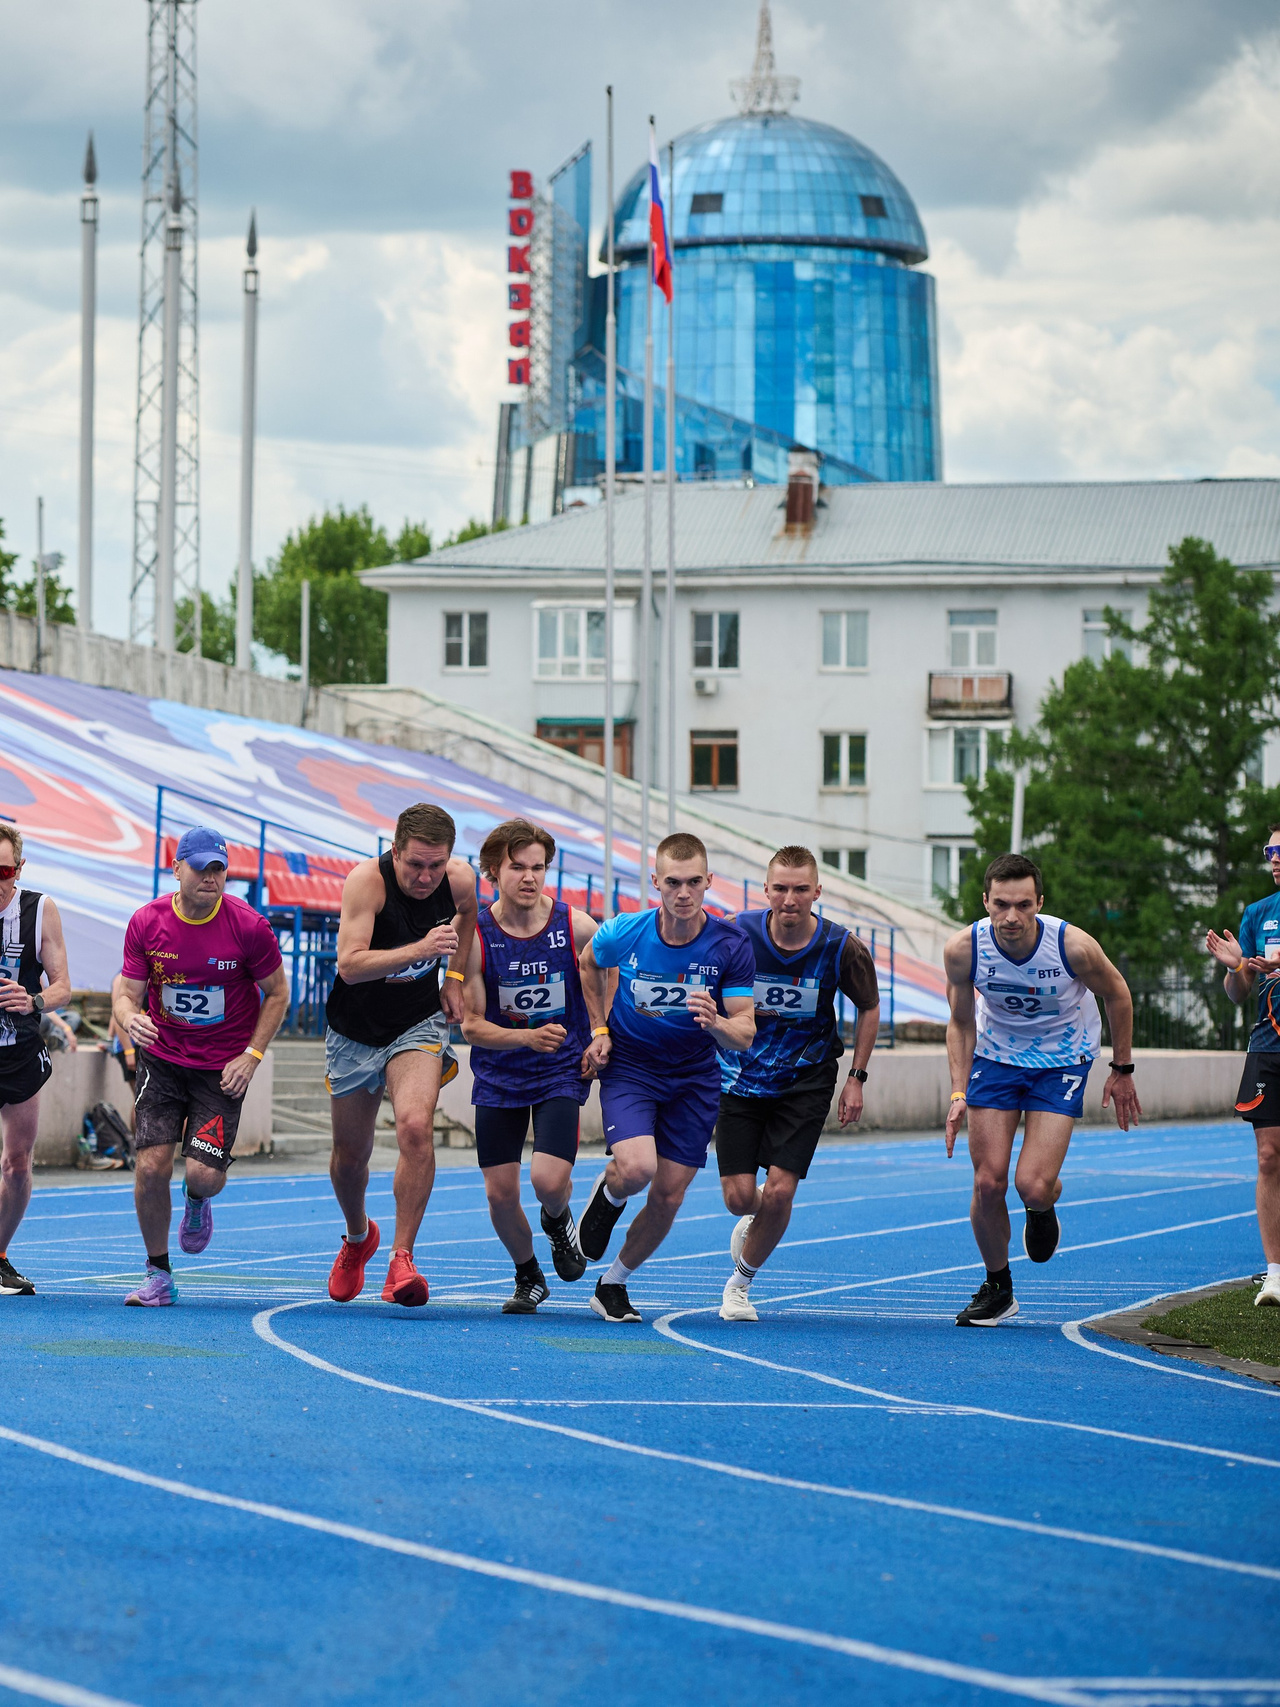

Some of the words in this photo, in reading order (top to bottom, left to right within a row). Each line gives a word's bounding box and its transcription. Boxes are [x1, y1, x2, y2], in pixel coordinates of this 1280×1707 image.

[508, 170, 534, 384] ВОКЗАЛ
[547, 930, 567, 949] 15
[217, 960, 238, 971] ВТБ
[521, 961, 549, 976] ВТБ
[628, 952, 639, 970] 4
[699, 965, 719, 976] ВТБ
[1038, 968, 1061, 979] ВТБ
[175, 992, 210, 1016] 52
[514, 987, 552, 1010] 62
[650, 986, 687, 1007] 22
[765, 986, 803, 1009] 82
[1004, 995, 1043, 1013] 92
[1061, 1073, 1083, 1101] 7
[190, 1136, 225, 1159] Reebok
